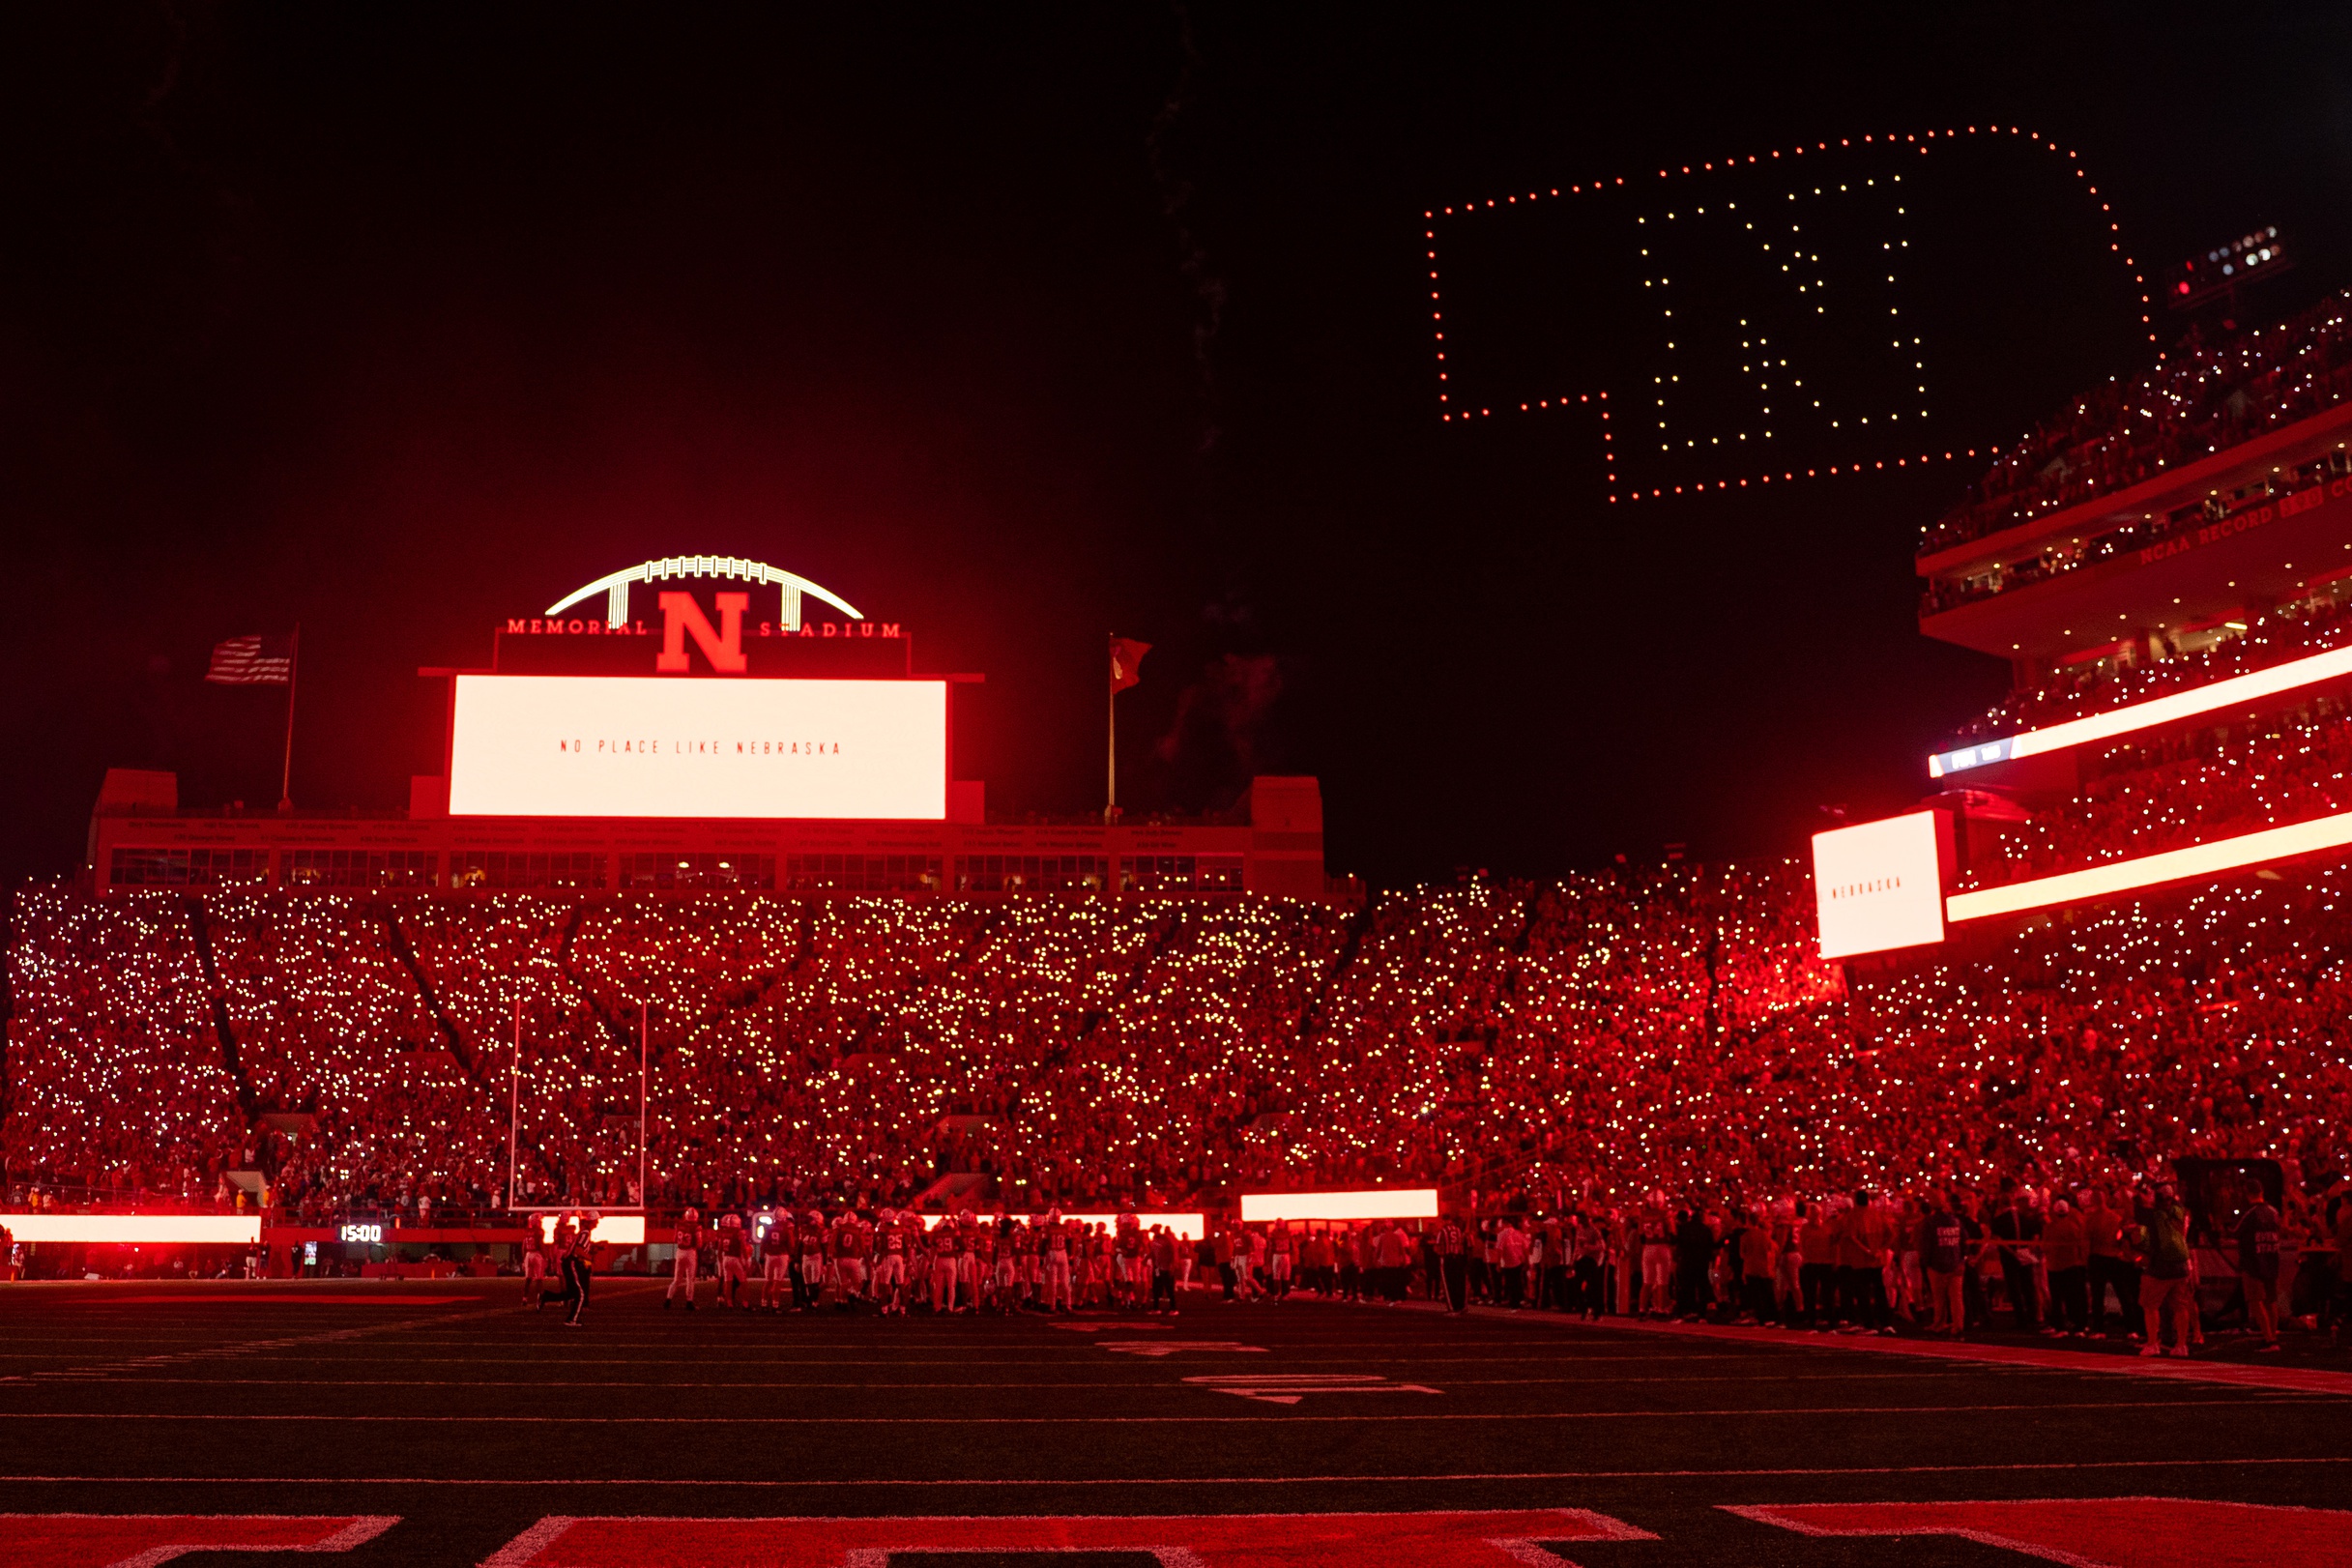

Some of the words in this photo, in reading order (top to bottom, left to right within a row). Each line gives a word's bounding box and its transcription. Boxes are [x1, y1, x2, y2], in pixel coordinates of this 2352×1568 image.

[2139, 535, 2191, 566] NCAA
[2197, 506, 2274, 546] RECORD
[508, 619, 647, 635] MEMORIAL
[760, 622, 901, 638] STADIUM
[656, 591, 749, 673] N
[561, 740, 581, 753] NO
[598, 740, 658, 754] PLACE
[676, 740, 720, 754] LIKE
[737, 740, 841, 755] NEBRASKA
[340, 1224, 381, 1242] 15:00
[887, 1234, 903, 1250] 25
